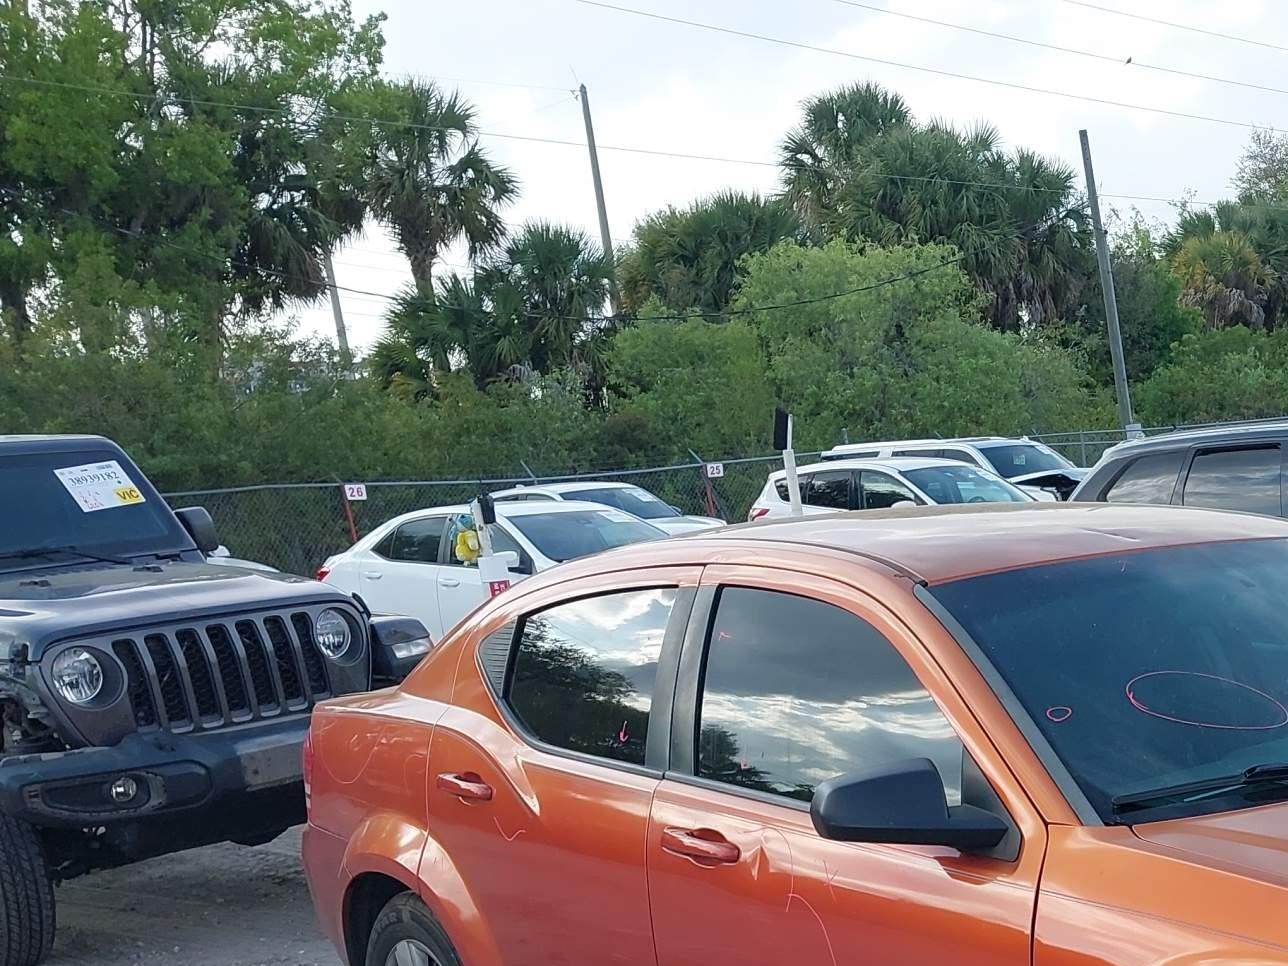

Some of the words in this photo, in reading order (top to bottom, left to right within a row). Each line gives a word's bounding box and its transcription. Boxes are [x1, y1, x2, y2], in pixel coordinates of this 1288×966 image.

[709, 465, 721, 476] 25
[69, 471, 120, 486] 38939182
[115, 489, 140, 501] VIC
[348, 486, 364, 498] 26
